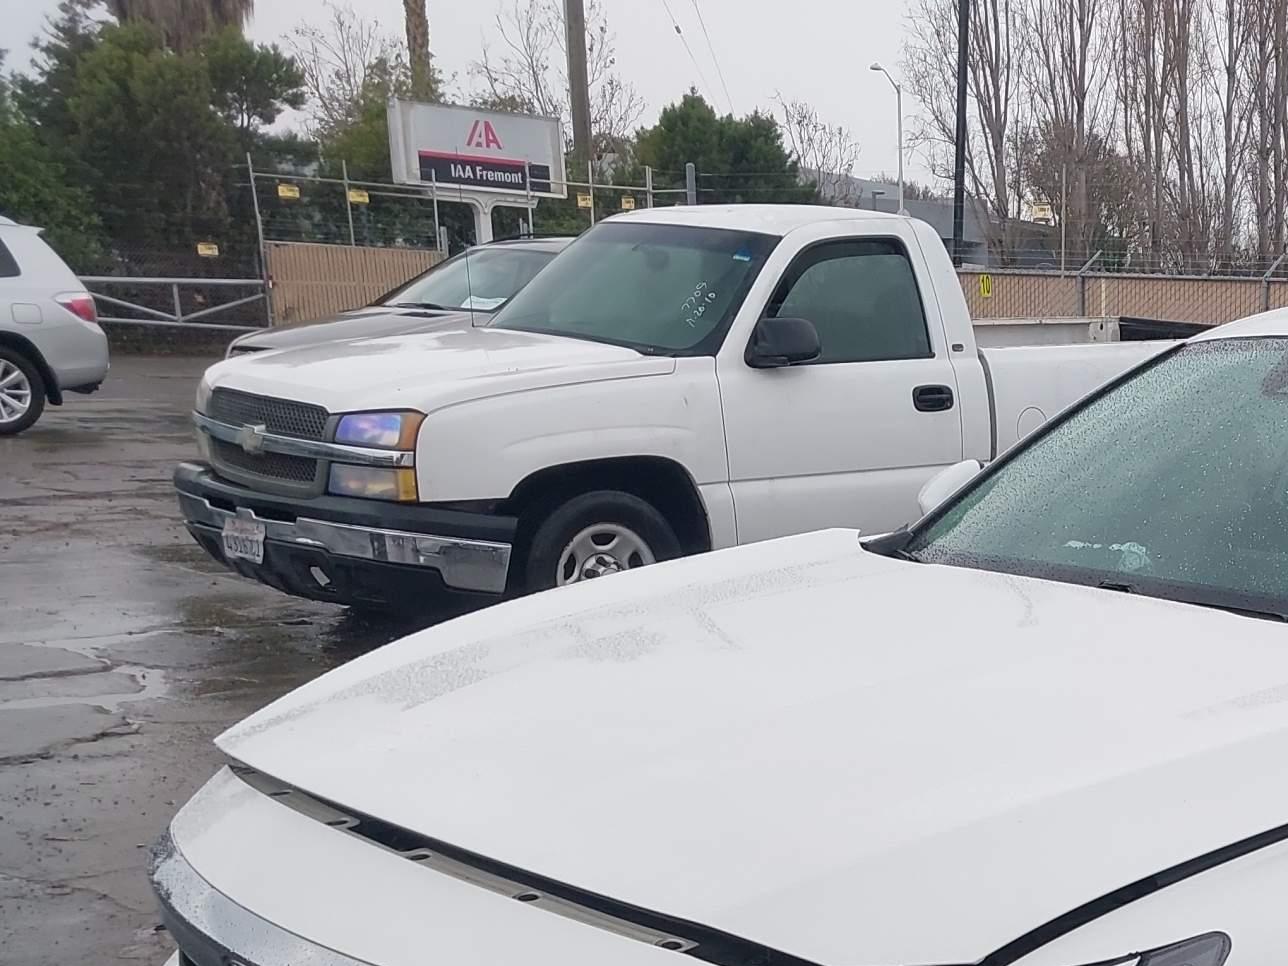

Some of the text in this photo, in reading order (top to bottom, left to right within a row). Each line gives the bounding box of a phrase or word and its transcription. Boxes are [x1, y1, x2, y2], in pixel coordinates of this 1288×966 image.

[451, 163, 523, 184] IAA Fremont
[981, 275, 991, 294] 10
